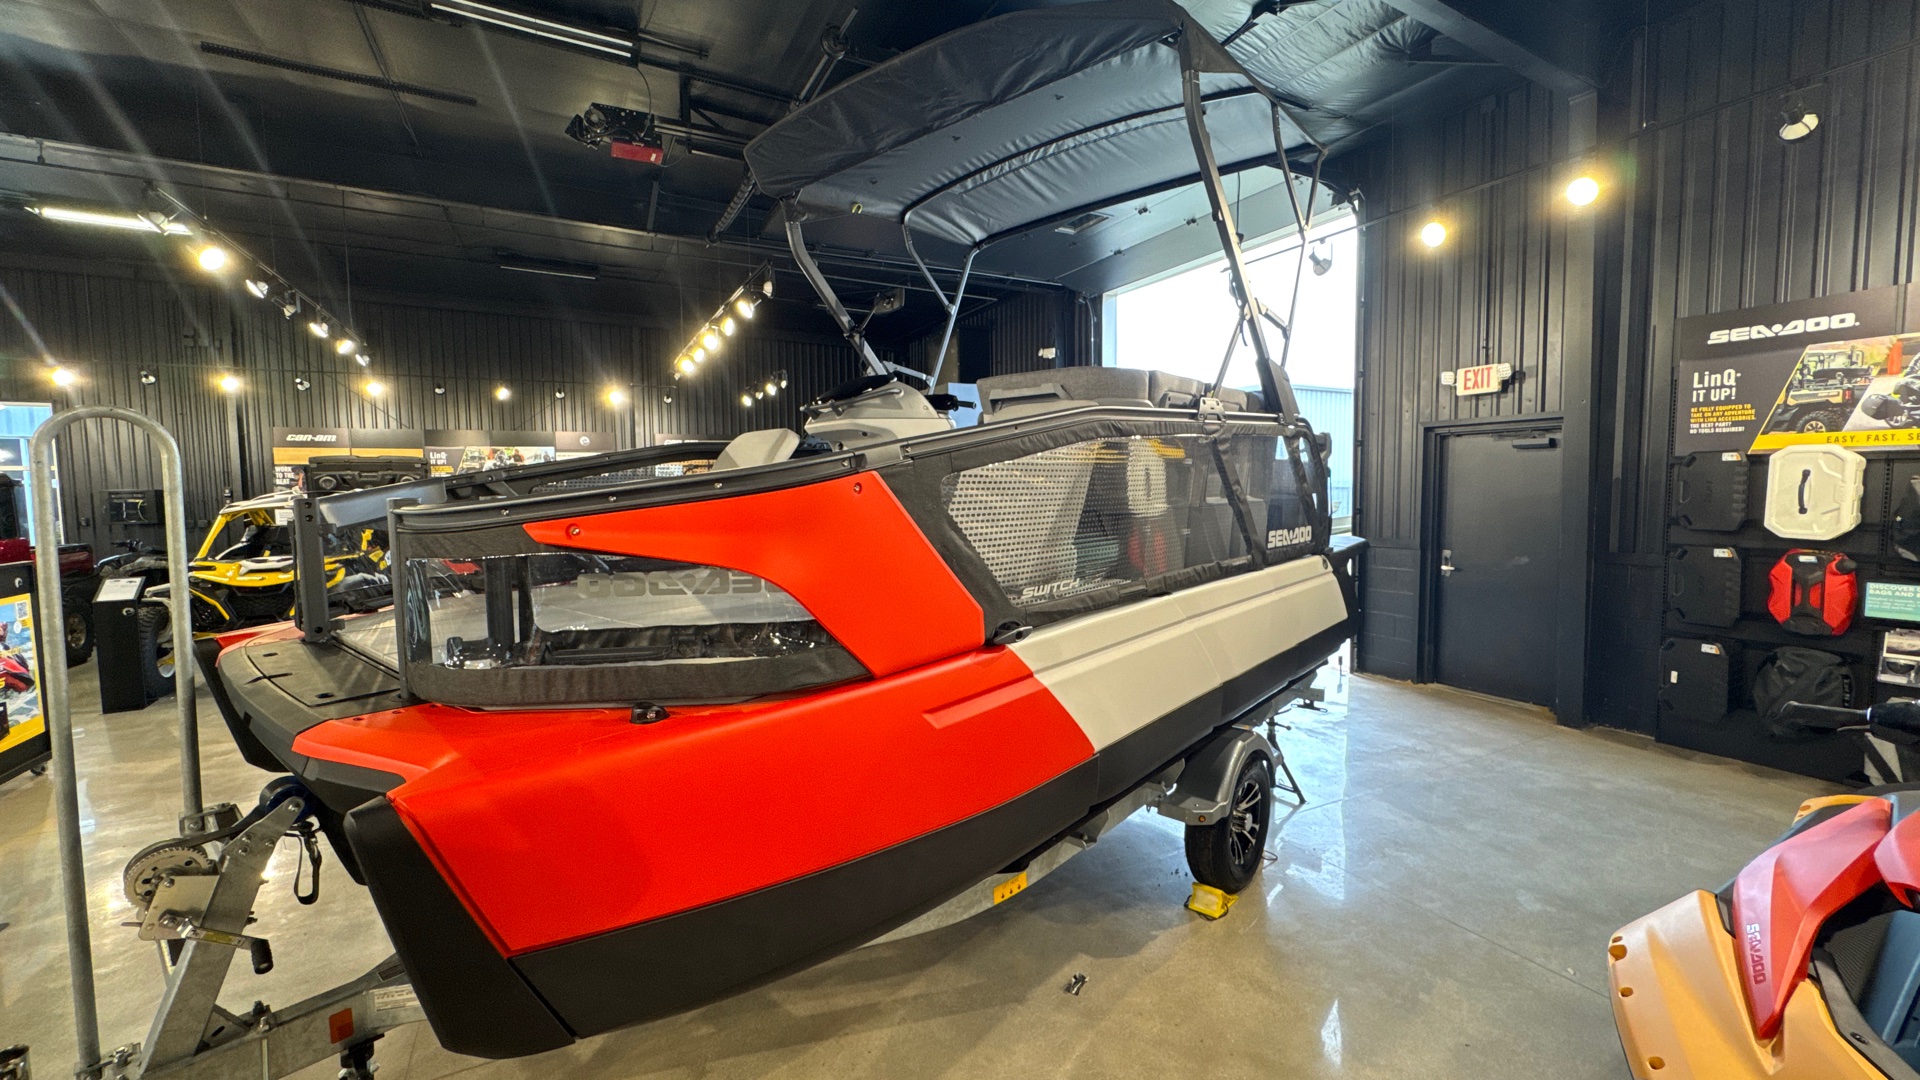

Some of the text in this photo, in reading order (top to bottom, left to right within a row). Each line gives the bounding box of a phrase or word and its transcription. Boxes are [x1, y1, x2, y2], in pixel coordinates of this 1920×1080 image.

[1463, 366, 1493, 391] EXIT
[1693, 368, 1737, 388] LinQ
[1692, 387, 1737, 403] IT UP!
[1826, 435, 1859, 444] EASY.
[1866, 433, 1900, 442] FAST.
[1020, 577, 1080, 600] SWITCH
[1868, 588, 1893, 596] BAGS
[1894, 590, 1915, 598] AND
[1869, 583, 1915, 592] DISCOVER
